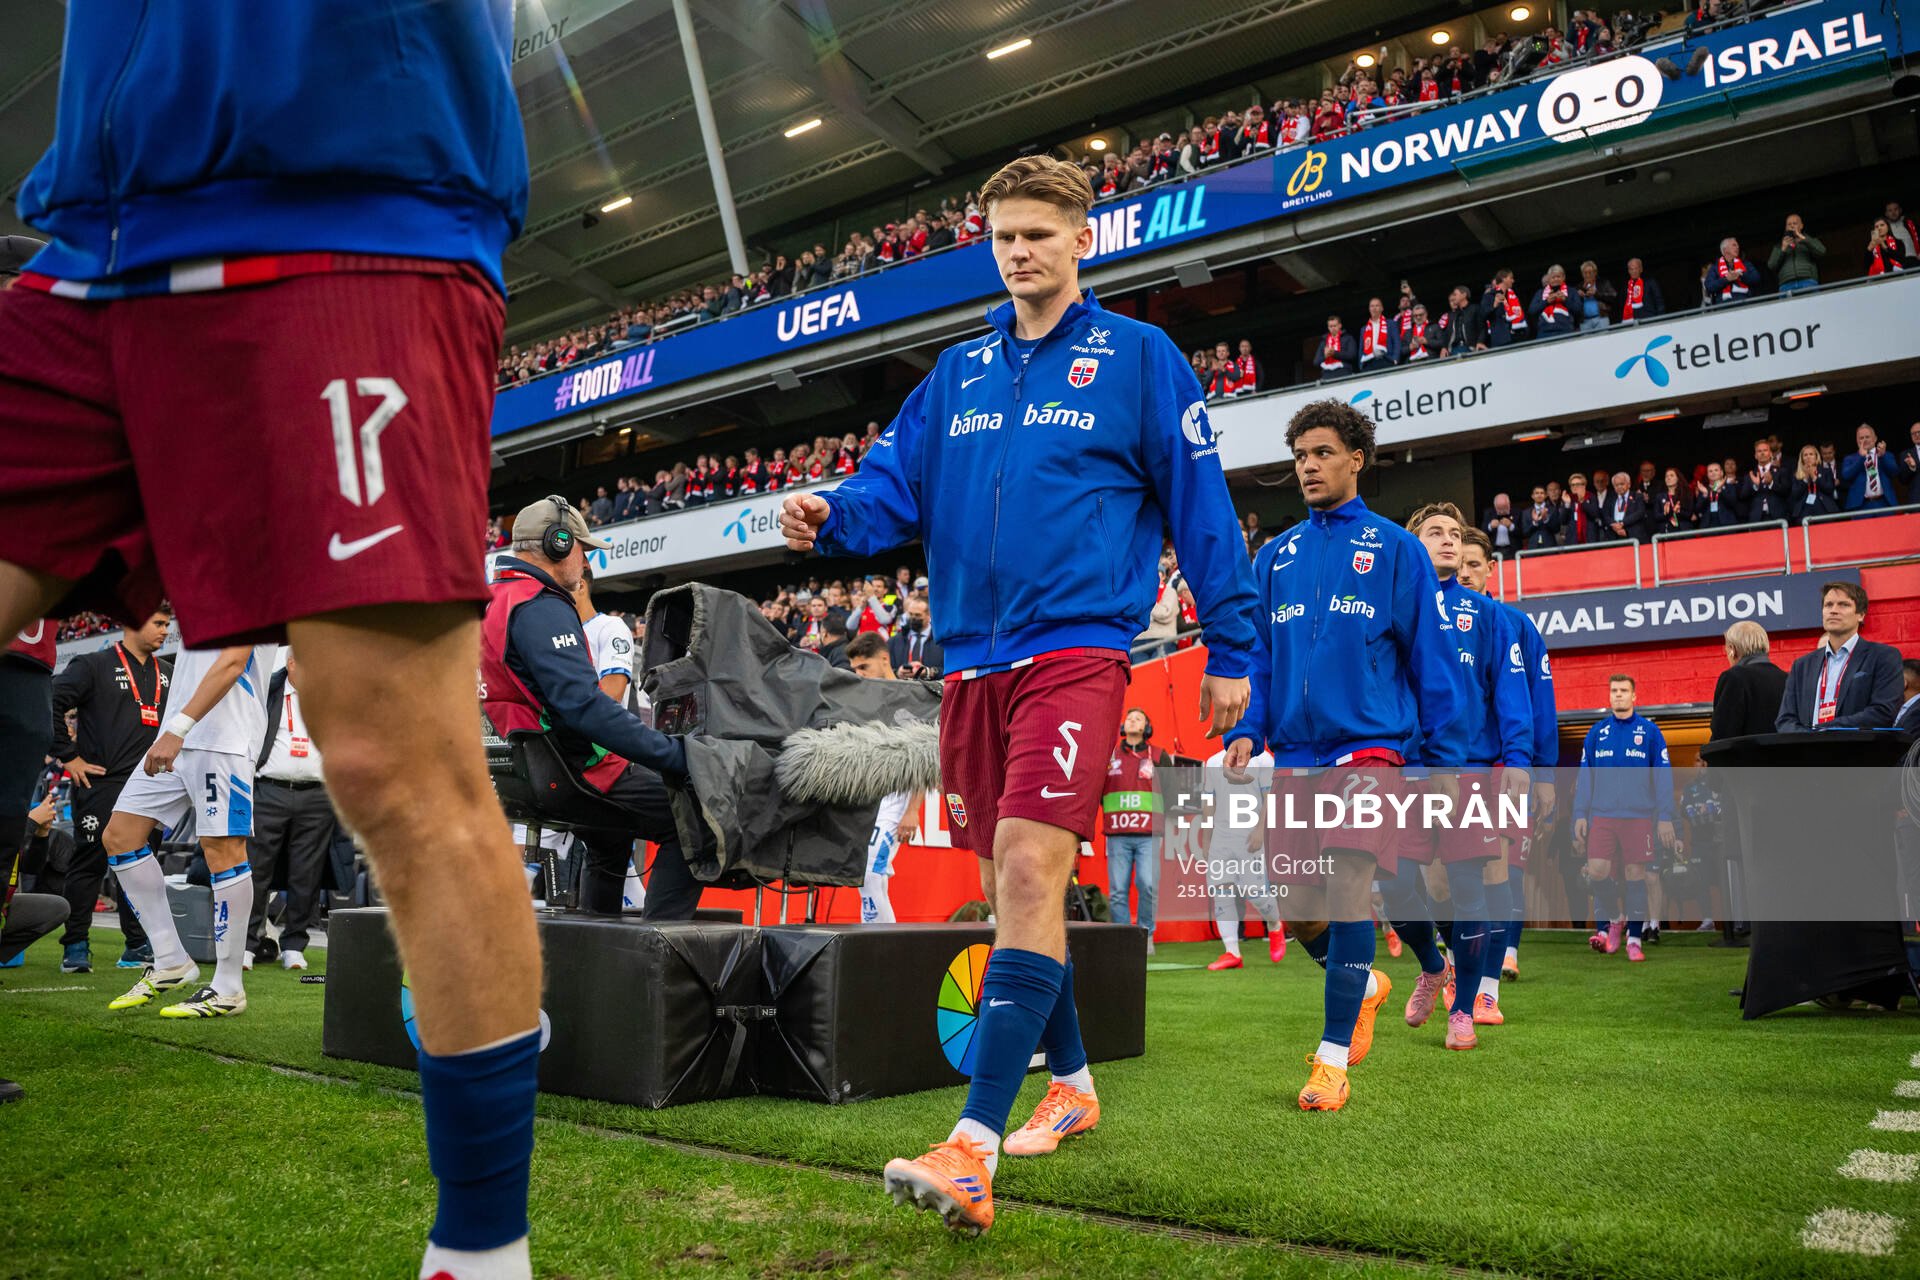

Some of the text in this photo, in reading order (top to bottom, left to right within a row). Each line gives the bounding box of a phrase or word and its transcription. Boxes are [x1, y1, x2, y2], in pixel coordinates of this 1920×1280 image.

[1341, 104, 1528, 183] NORWAY
[1704, 12, 1883, 88] ISRAEL
[1144, 184, 1206, 243] ALL
[1282, 190, 1333, 209] BREITLING
[776, 290, 861, 342] UEFA
[1672, 322, 1822, 372] telenor
[554, 349, 656, 411] #FOOTBALL
[1370, 380, 1493, 424] telenor
[320, 377, 409, 507] 17
[610, 534, 667, 560] telenor
[1527, 590, 1784, 636] VAAL STADION
[552, 633, 577, 648] HH
[1053, 720, 1082, 782] 5
[205, 773, 217, 802] 5
[1119, 794, 1141, 808] HB
[1111, 812, 1150, 829] 1027
